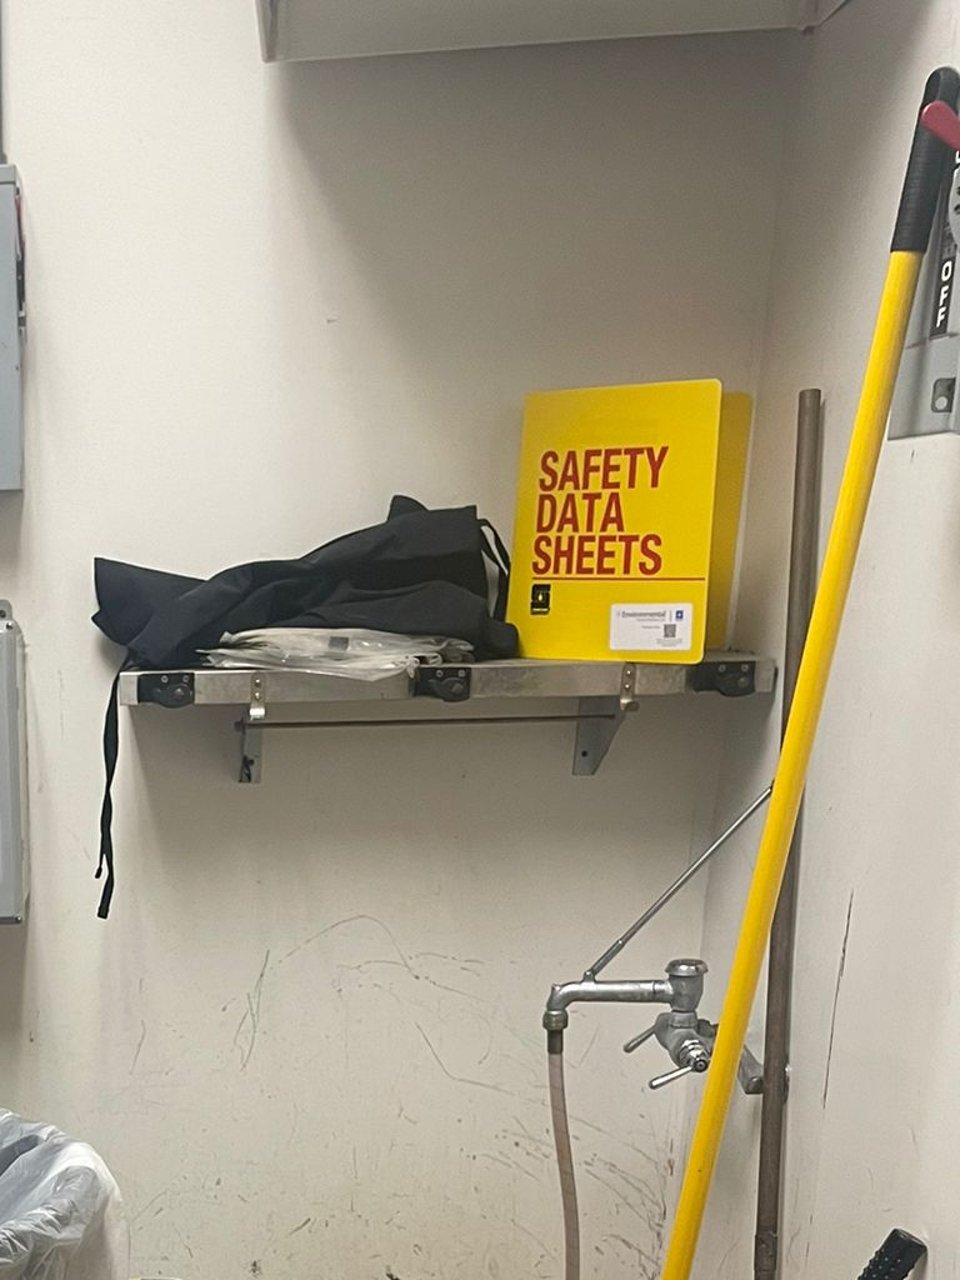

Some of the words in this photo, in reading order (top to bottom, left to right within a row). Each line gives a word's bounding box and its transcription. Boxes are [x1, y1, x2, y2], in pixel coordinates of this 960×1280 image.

[935, 260, 953, 329] OFF
[538, 445, 669, 492] SAFETY
[536, 492, 625, 533] DATA
[531, 533, 663, 576] SHEETS
